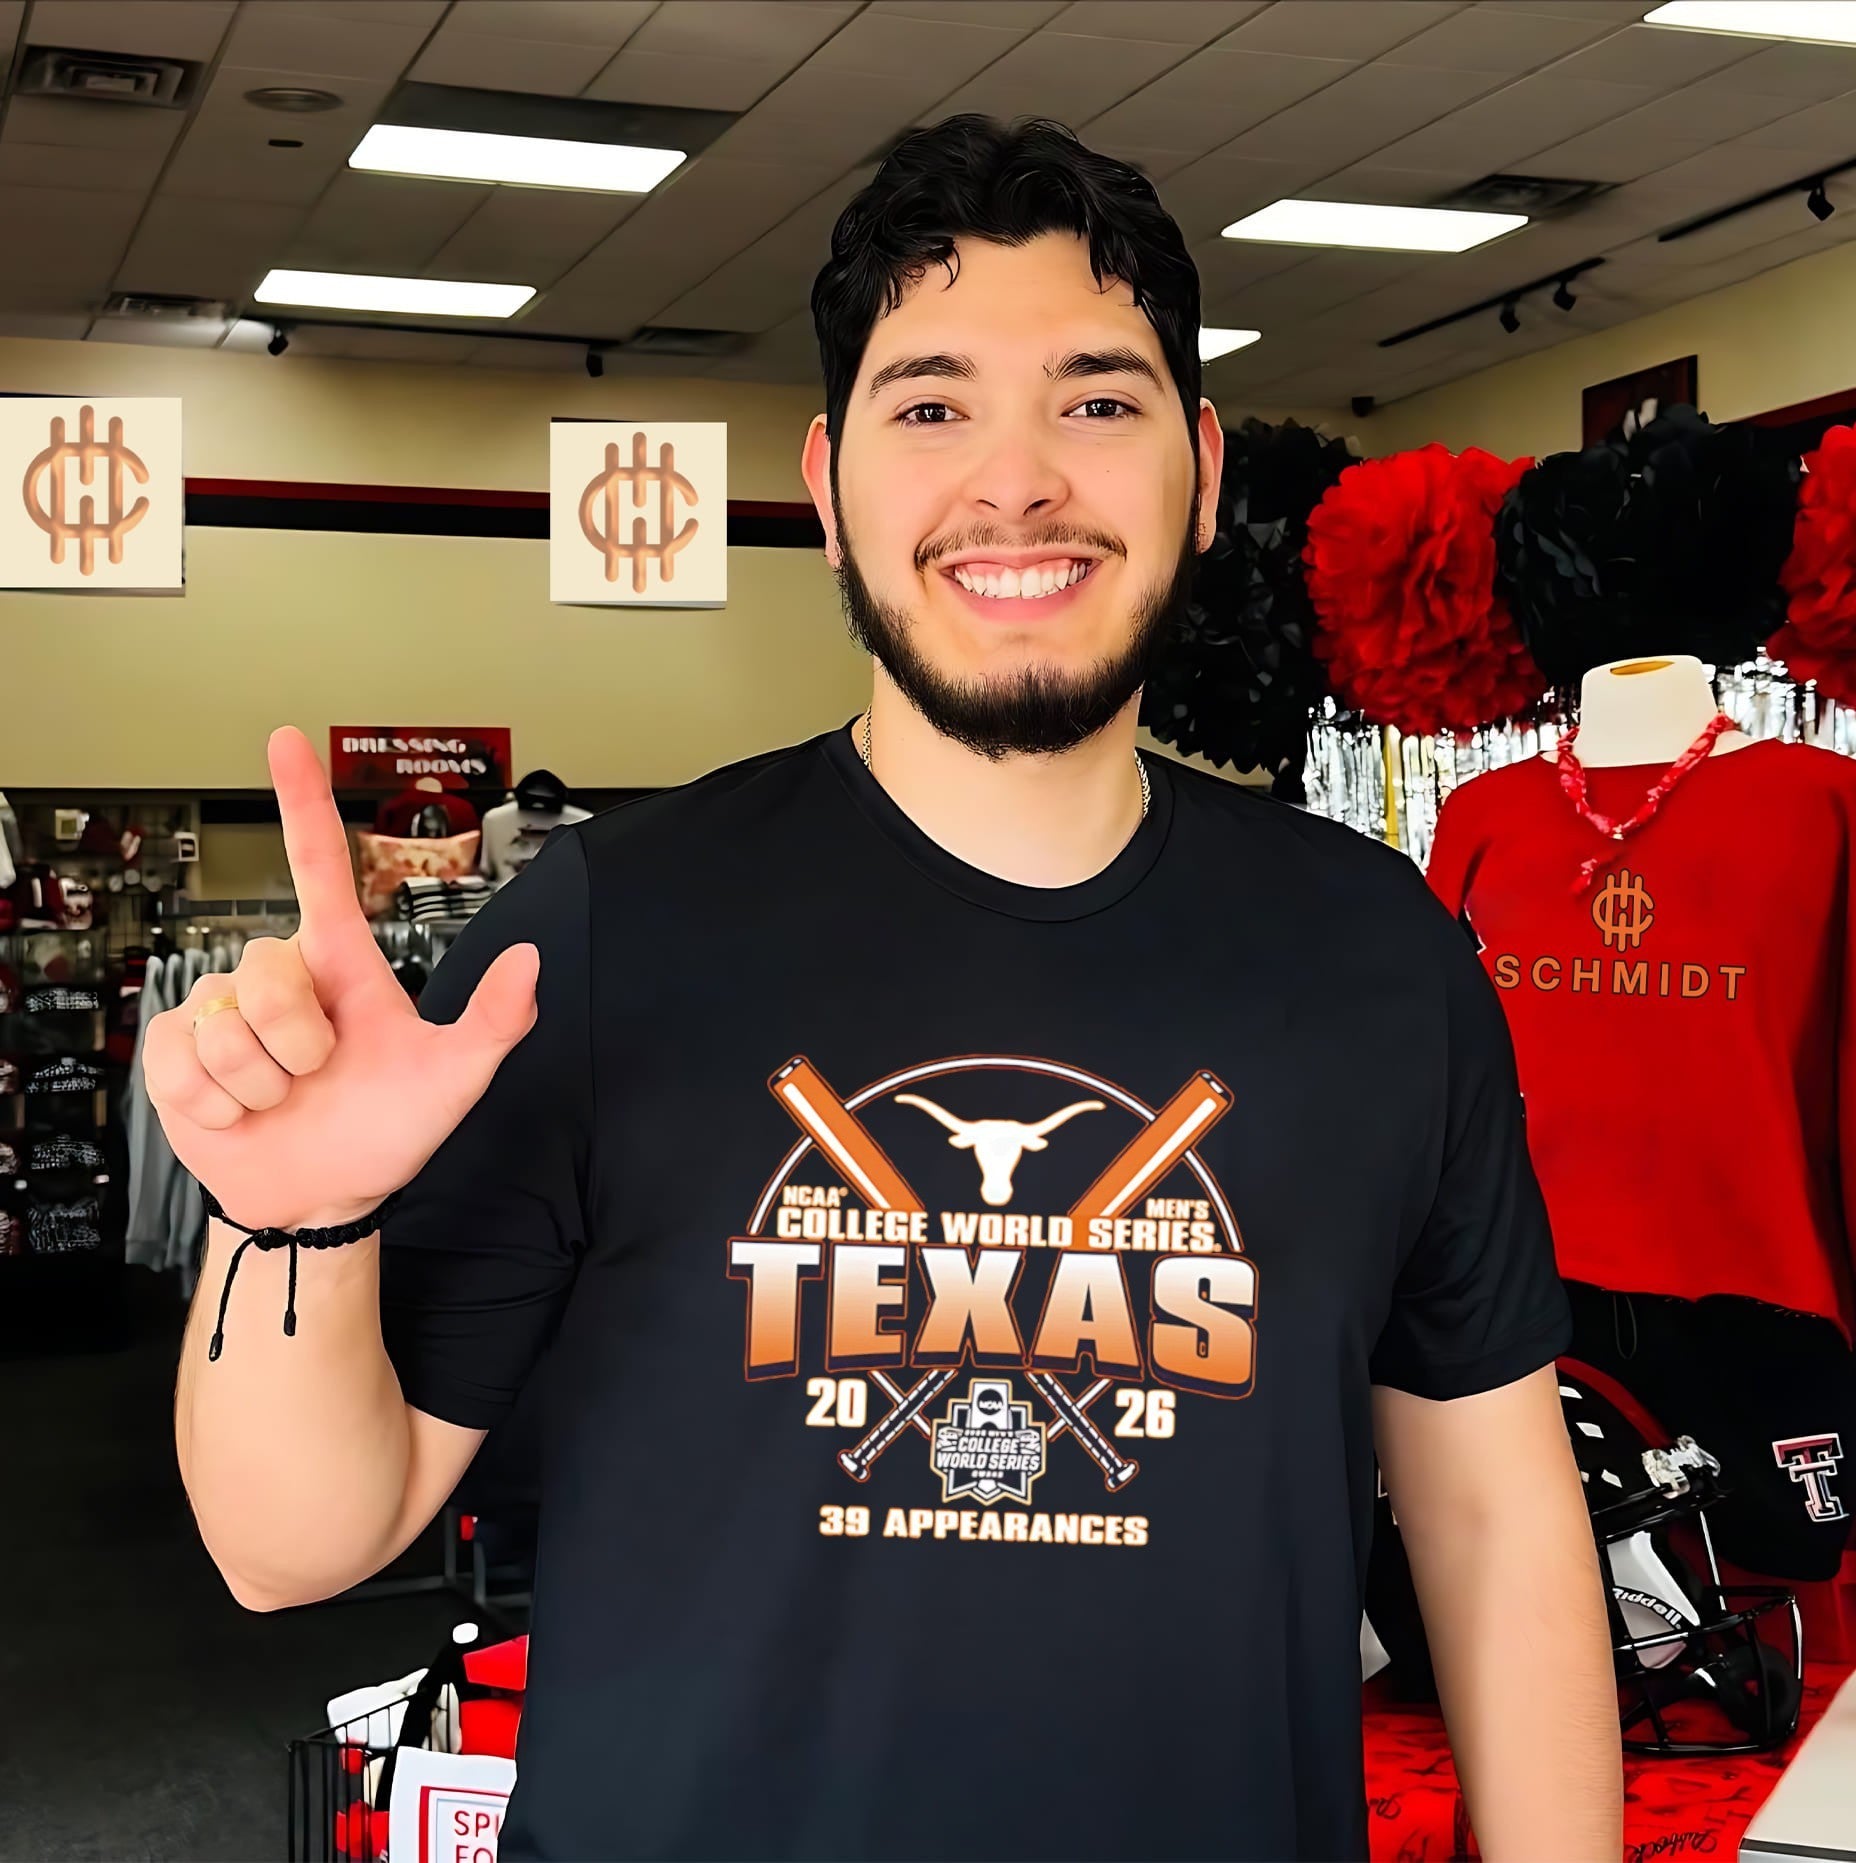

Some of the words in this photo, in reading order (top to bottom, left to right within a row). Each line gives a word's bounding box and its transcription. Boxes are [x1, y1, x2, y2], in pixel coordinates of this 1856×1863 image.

[1494, 953, 1747, 1000] SCHMIDT
[776, 1206, 928, 1243] COLLEGE
[940, 1212, 1074, 1248] WORLD
[1145, 1198, 1210, 1221] MEN'S
[726, 1237, 1259, 1400] TEXAS
[806, 1377, 868, 1427] 20
[1114, 1388, 1176, 1438] 26
[936, 1452, 988, 1469] WORLD
[988, 1454, 1041, 1472] SERIES
[957, 1437, 1020, 1454] COLLEGE
[819, 1505, 870, 1536] 39
[882, 1507, 1150, 1546] APPEARANCES
